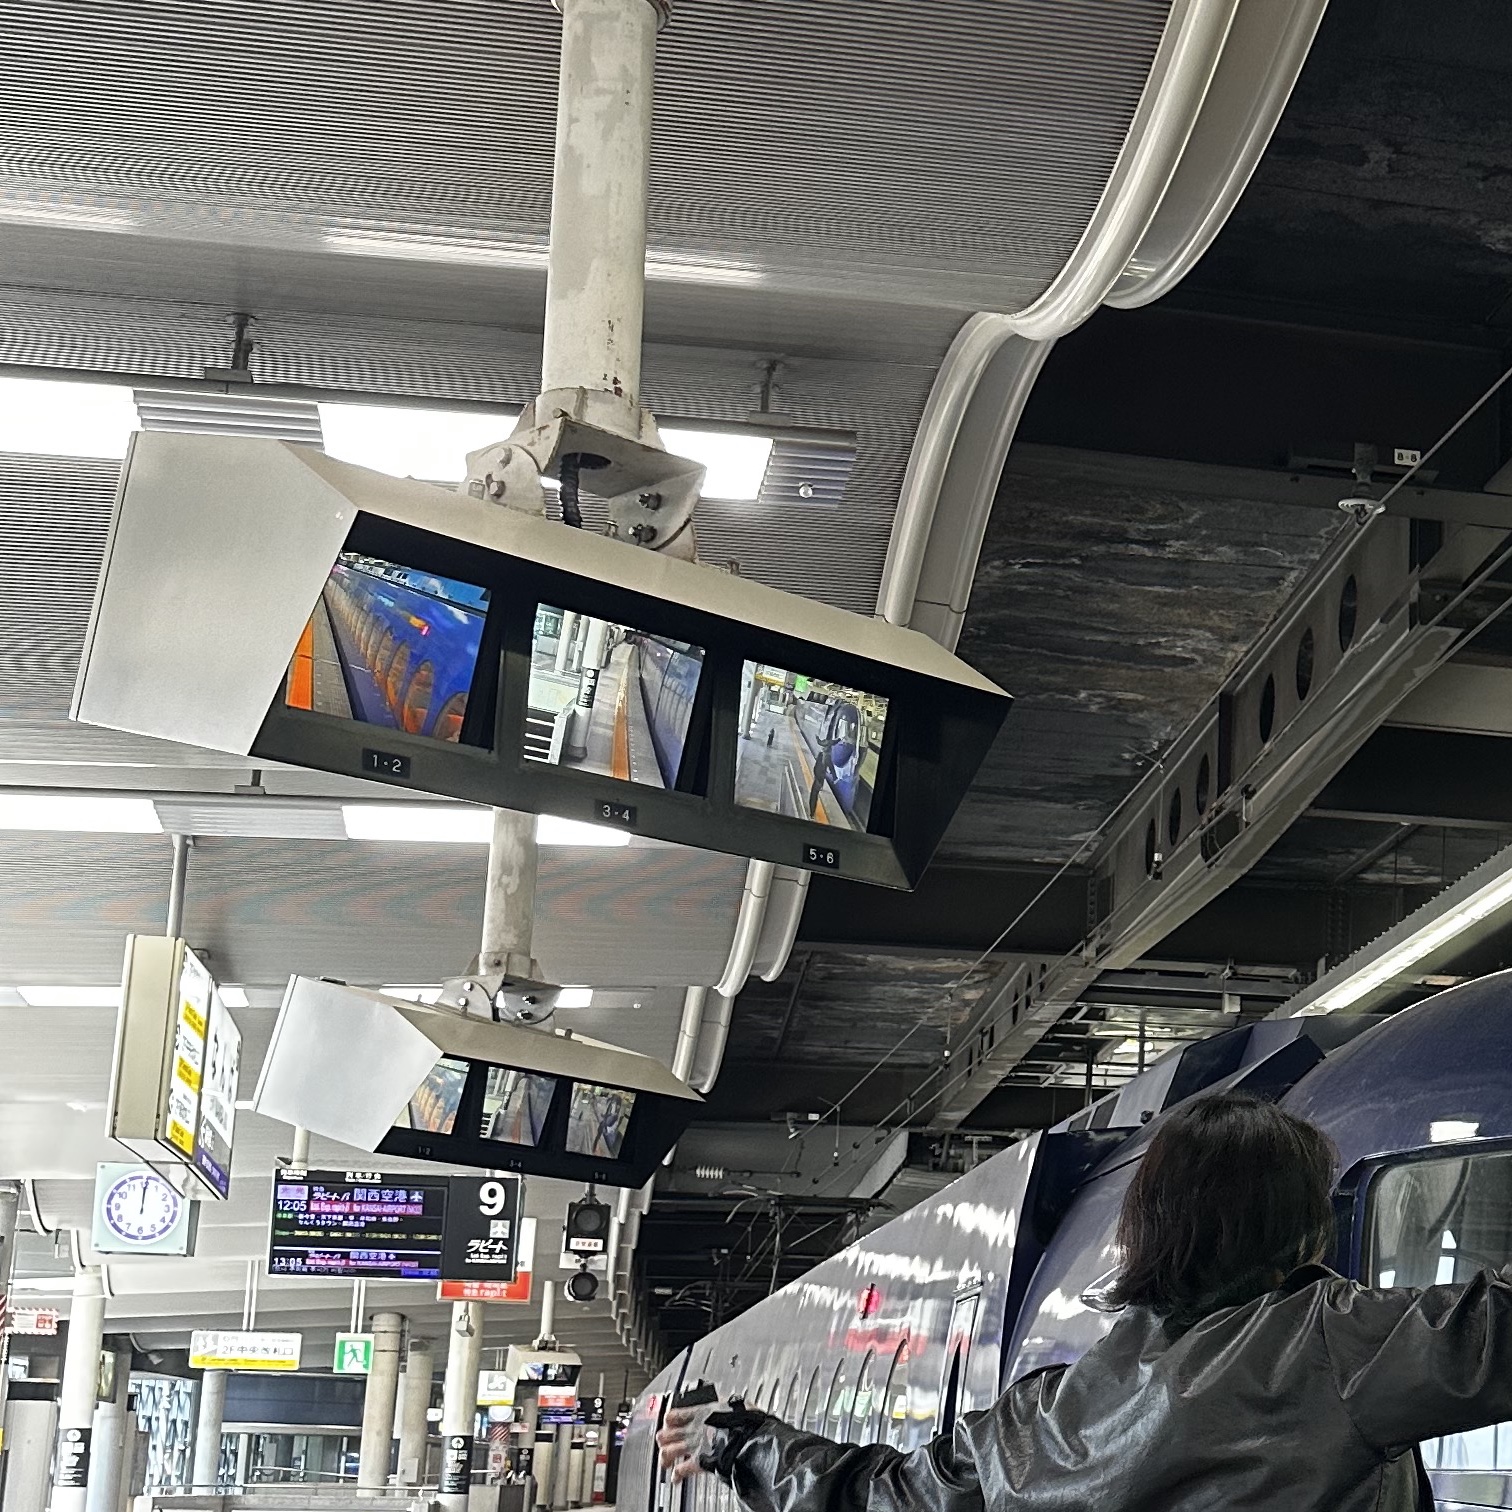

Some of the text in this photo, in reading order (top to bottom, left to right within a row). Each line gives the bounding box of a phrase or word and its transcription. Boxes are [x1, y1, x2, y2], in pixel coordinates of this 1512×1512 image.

[127, 1184, 136, 1192] 11
[118, 1191, 127, 1200] 10
[162, 1193, 168, 1201] 2
[353, 1188, 408, 1203] 関西空港
[479, 1181, 506, 1216] 9
[114, 1203, 121, 1211] 9
[164, 1205, 170, 1213] 3
[278, 1200, 307, 1211] 12:05
[117, 1214, 123, 1222] 8
[160, 1216, 166, 1224] 4
[126, 1223, 131, 1231] 7
[137, 1226, 143, 1234] 6
[150, 1224, 156, 1232] 5
